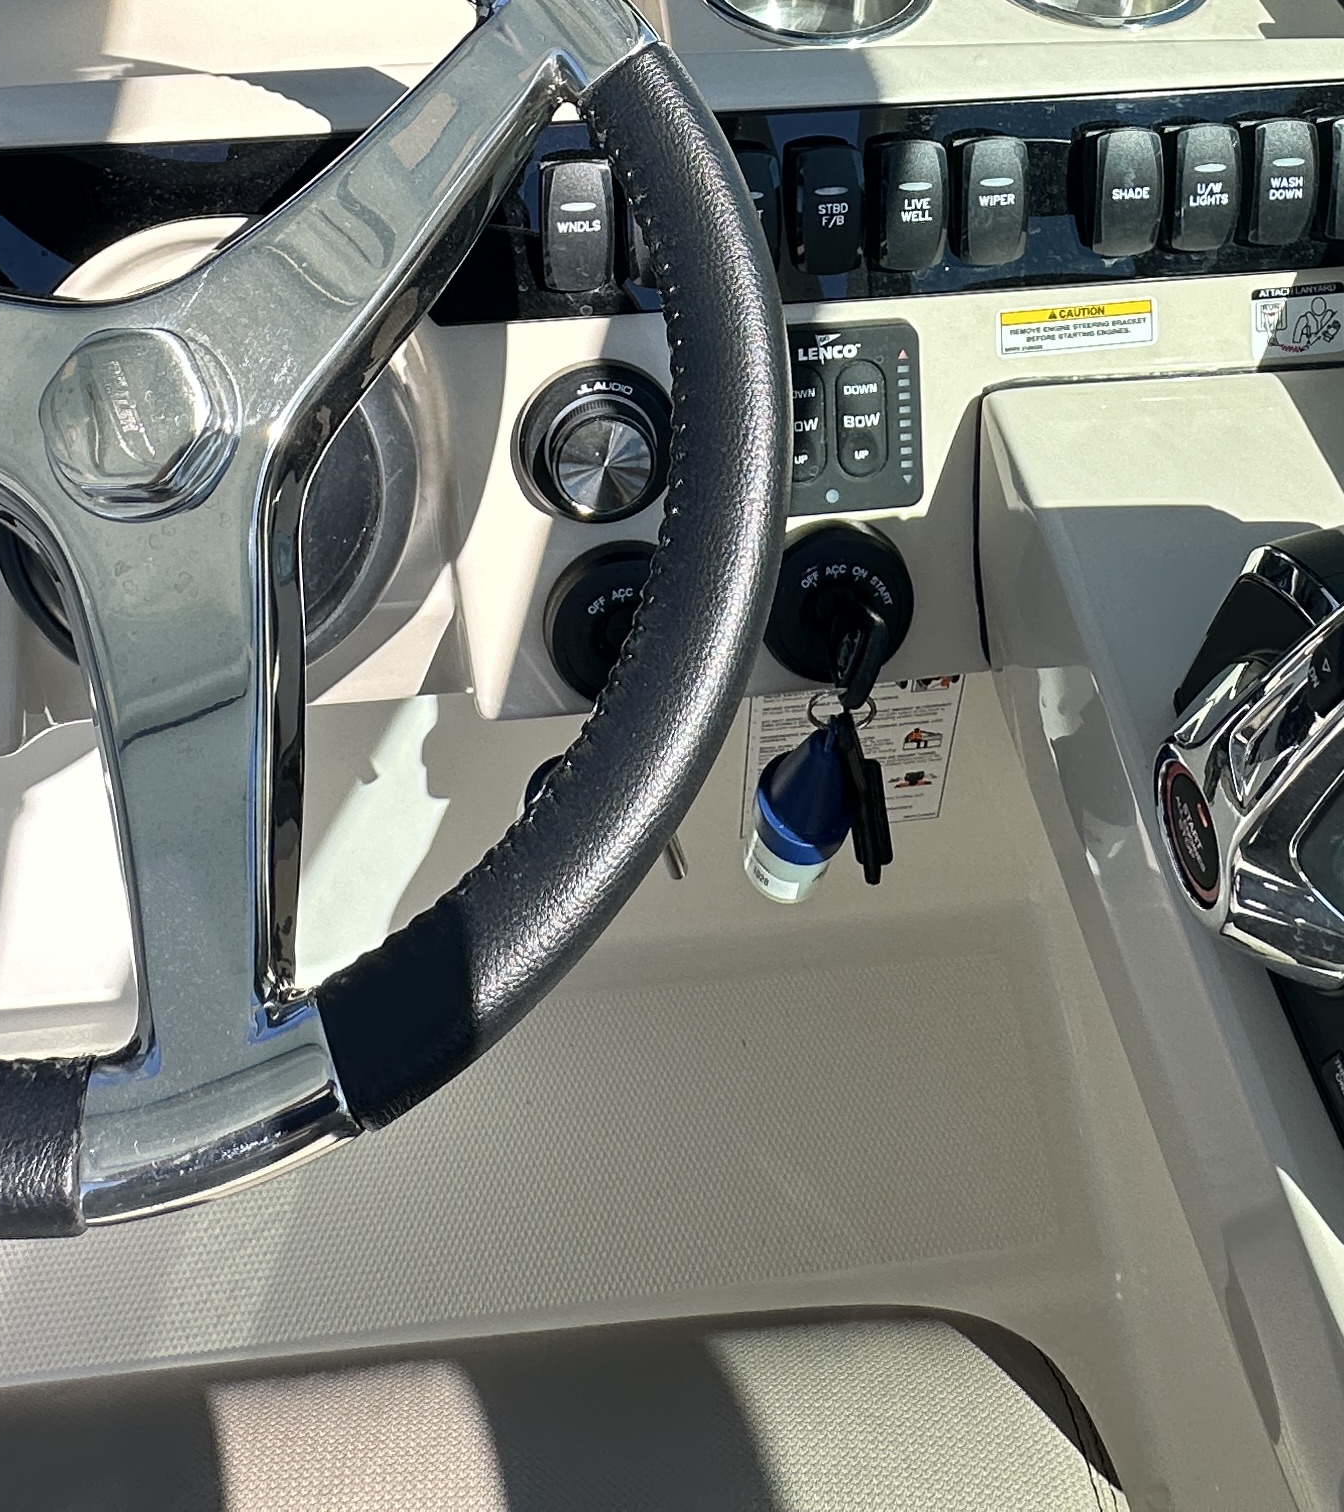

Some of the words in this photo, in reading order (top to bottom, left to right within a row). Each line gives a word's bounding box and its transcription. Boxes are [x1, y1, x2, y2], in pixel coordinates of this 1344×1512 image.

[1197, 182, 1223, 194] U/W
[1270, 176, 1303, 188] WASH
[978, 193, 1016, 207] WIPER
[1111, 187, 1150, 201] SHADE
[1189, 194, 1229, 207] LIGHTS
[1269, 188, 1303, 200] DOWN
[818, 202, 848, 215] STBD
[904, 198, 931, 211] LIVE
[822, 216, 845, 228] F/B
[901, 210, 933, 223] WELL
[557, 220, 601, 234] WNDLS
[1296, 284, 1337, 296] LANYARD
[1059, 305, 1106, 319] CAUTION
[1010, 326, 1041, 336] REMOVE
[1072, 320, 1110, 330] STEERING
[1112, 316, 1147, 327] BRACKET
[1026, 334, 1056, 343] BEFORE
[1058, 331, 1096, 340] STARTING
[798, 343, 858, 362] LENCO
[577, 383, 593, 395] JL
[593, 381, 634, 395] AUDIO
[792, 388, 816, 399] OWN
[843, 383, 878, 395] DOWN
[794, 417, 819, 432] OW
[843, 412, 881, 428] BOW
[794, 454, 808, 465] UP
[854, 449, 870, 460] UP
[801, 571, 819, 588] OFF
[825, 564, 847, 576] ACC
[852, 566, 868, 578] ON
[870, 575, 893, 605] START
[587, 595, 606, 615] OFF
[611, 587, 634, 601] ACC
[1182, 802, 1203, 849] START
